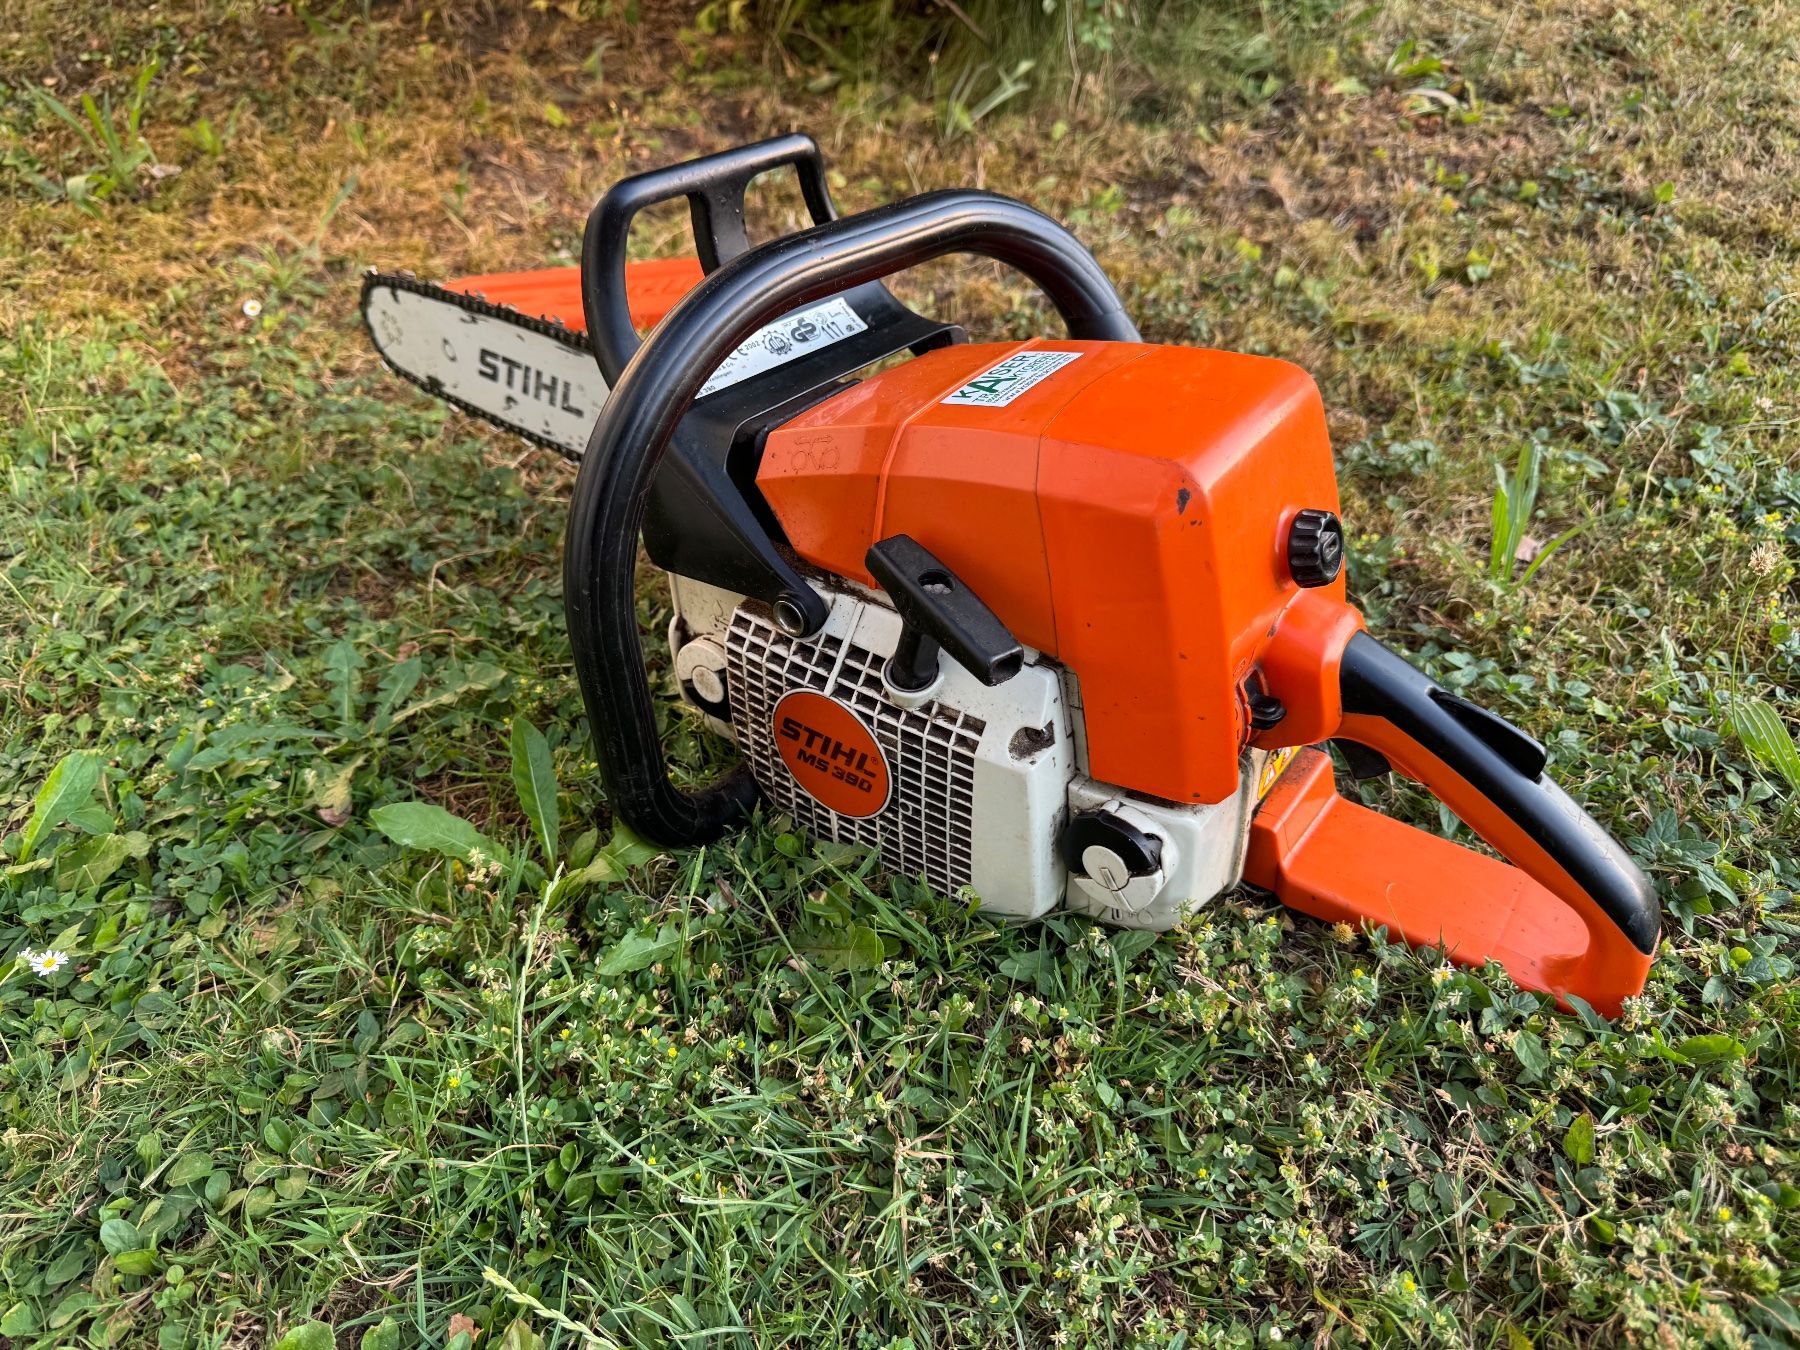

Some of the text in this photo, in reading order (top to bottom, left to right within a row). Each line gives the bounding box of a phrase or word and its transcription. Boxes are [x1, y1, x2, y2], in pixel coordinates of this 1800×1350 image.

[744, 340, 760, 351] 2002
[790, 316, 818, 343] GS
[478, 348, 585, 418] STIHL
[951, 355, 1036, 399] KAISER
[780, 717, 877, 779] STIHL
[797, 748, 873, 793] MS 390
